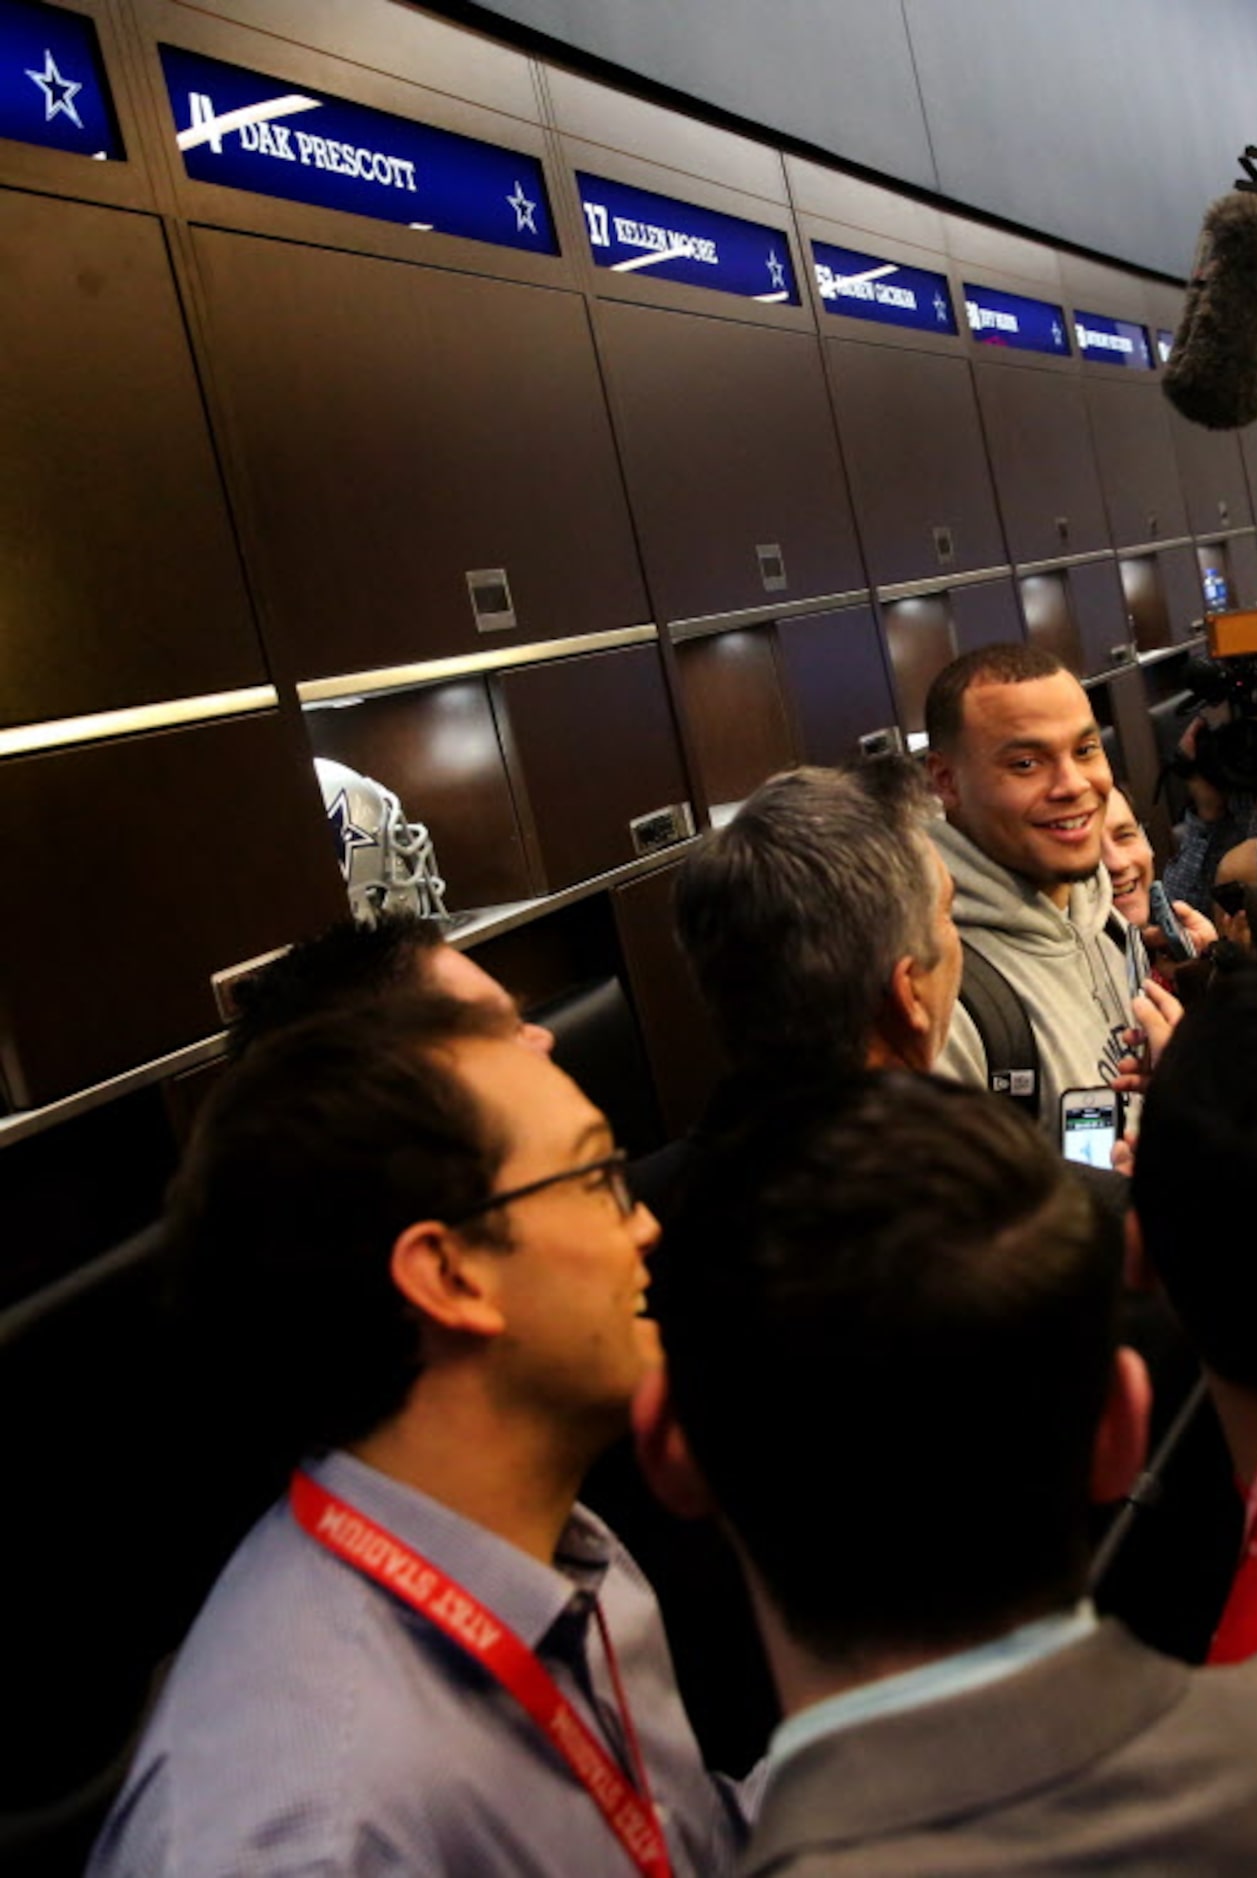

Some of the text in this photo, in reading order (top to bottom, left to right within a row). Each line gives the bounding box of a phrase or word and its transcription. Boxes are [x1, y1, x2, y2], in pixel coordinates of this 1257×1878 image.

[239, 122, 297, 161] DAK
[294, 131, 418, 192] PRESCOTT
[583, 202, 611, 247] 17
[612, 217, 669, 251] KELLEN
[317, 1504, 501, 1650] AT&T STADIUM
